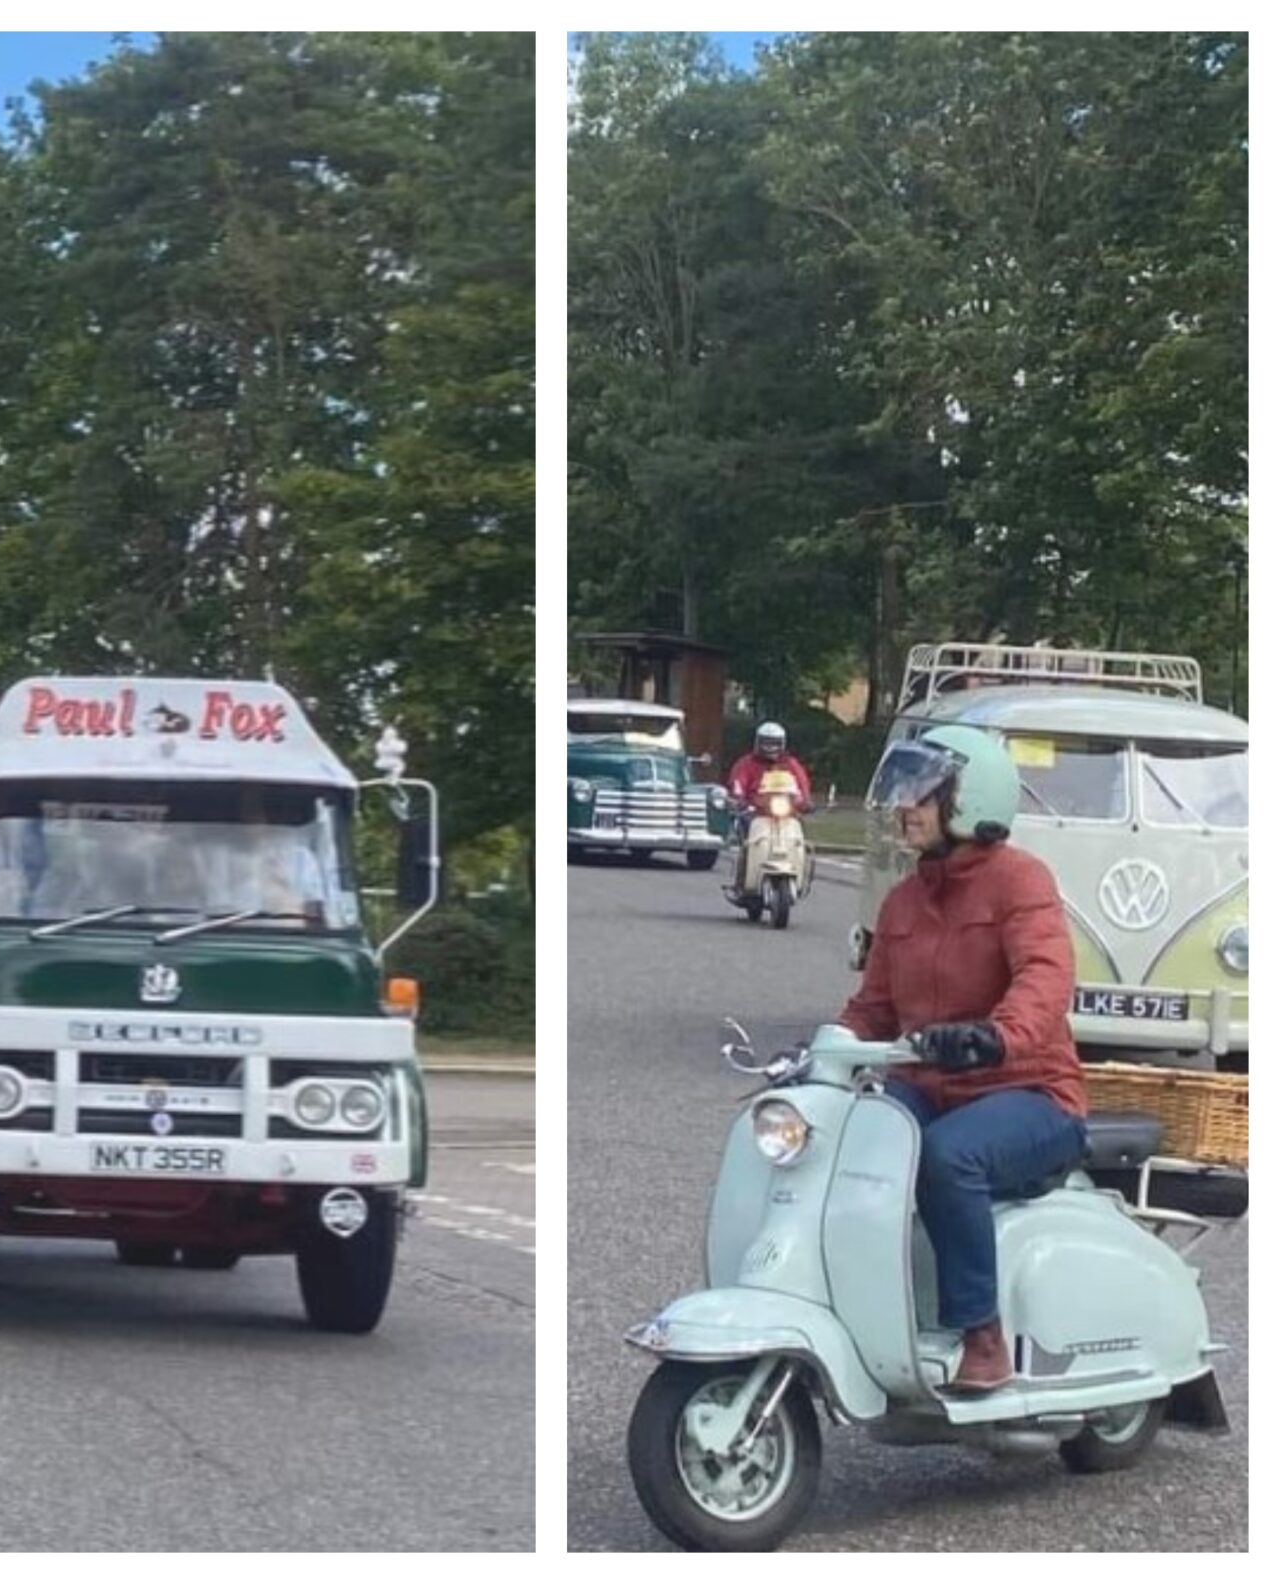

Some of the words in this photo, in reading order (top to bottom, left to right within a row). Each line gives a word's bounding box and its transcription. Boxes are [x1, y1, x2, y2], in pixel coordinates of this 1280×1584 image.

[23, 687, 138, 737] Paul
[199, 691, 288, 743] Fox
[1078, 991, 1126, 1014] LKE
[95, 1145, 148, 1168] NKT
[153, 1146, 225, 1170] 355R
